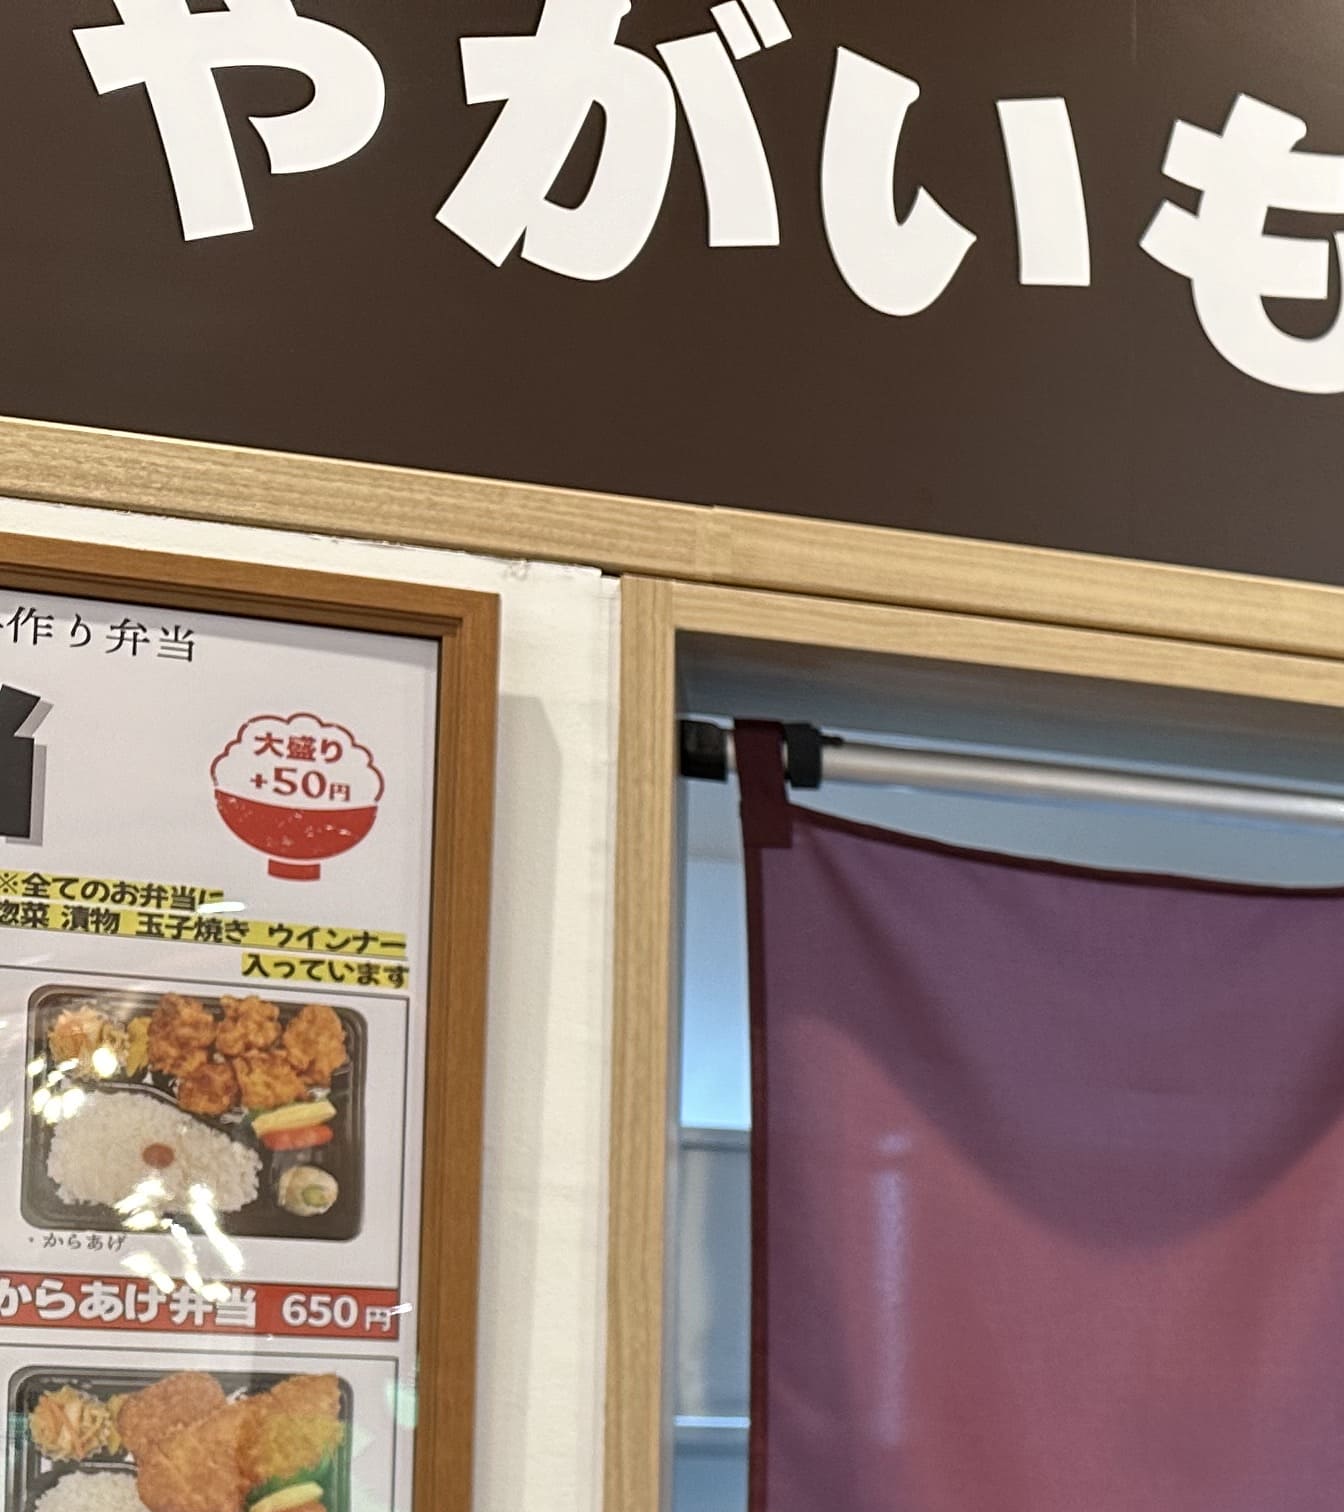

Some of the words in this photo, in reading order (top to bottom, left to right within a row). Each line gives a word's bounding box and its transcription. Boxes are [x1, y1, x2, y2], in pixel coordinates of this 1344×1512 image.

[0, 606, 195, 662] 作り弁当
[253, 731, 344, 764] 大盛り
[136, 912, 249, 944] 玉子焼き
[268, 922, 406, 954] ウインナー
[242, 953, 409, 989] 入っています
